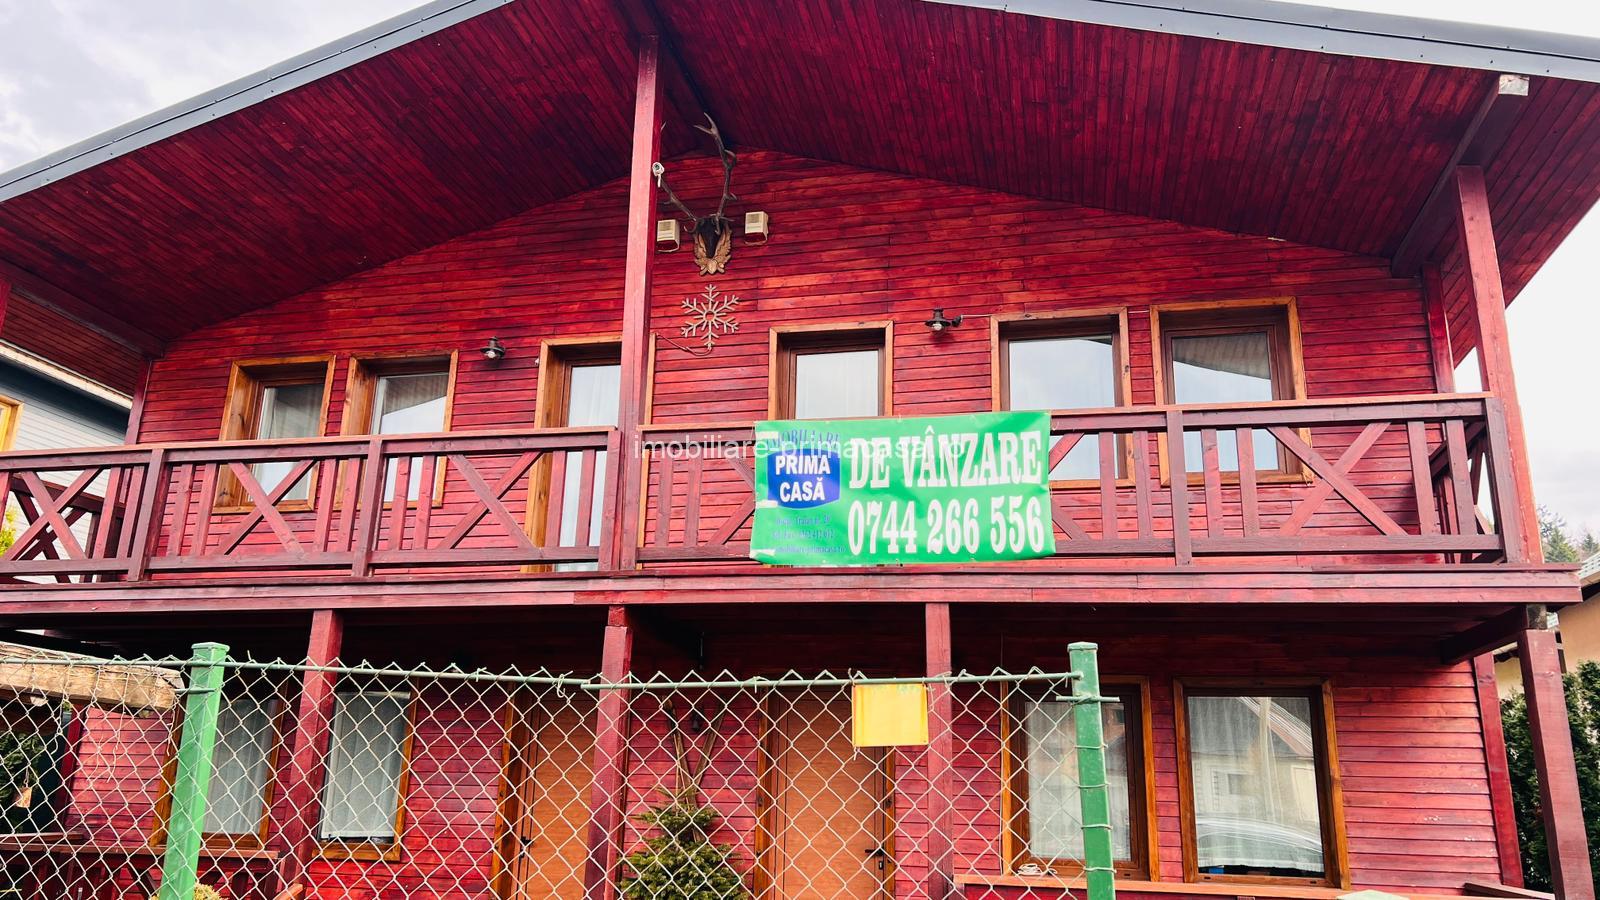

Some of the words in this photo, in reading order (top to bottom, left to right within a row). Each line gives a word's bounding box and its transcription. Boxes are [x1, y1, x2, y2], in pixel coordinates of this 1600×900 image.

[776, 455, 830, 475] PRIMA
[849, 436, 890, 489] DE
[899, 425, 1042, 488] VÂNZARE
[780, 478, 825, 501] CASĂ
[848, 501, 917, 555] 0744
[927, 498, 980, 554] 266
[990, 496, 1044, 554] 556
